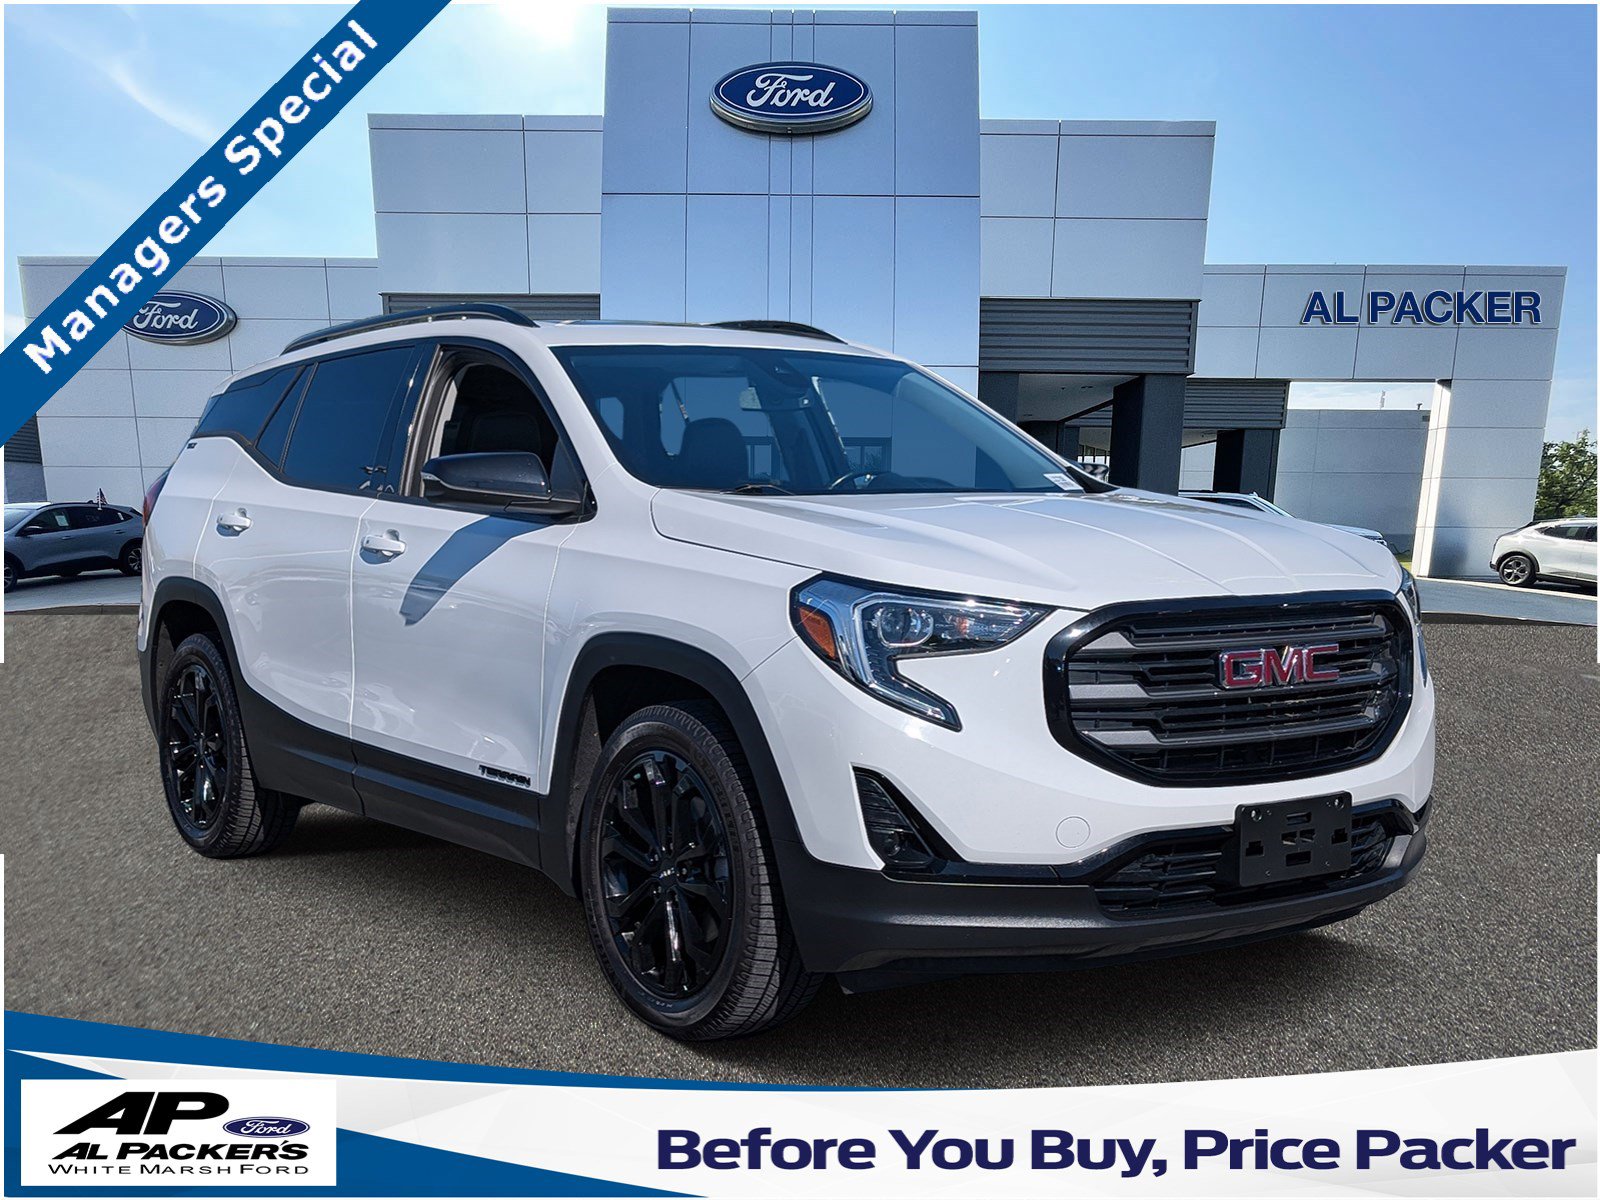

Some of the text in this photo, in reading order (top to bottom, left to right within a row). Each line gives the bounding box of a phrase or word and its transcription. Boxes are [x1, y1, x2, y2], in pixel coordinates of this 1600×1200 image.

[746, 73, 836, 107] Ford
[133, 301, 199, 329] Ford
[1302, 290, 1542, 323] AL PACKER
[1219, 643, 1340, 688] GMC
